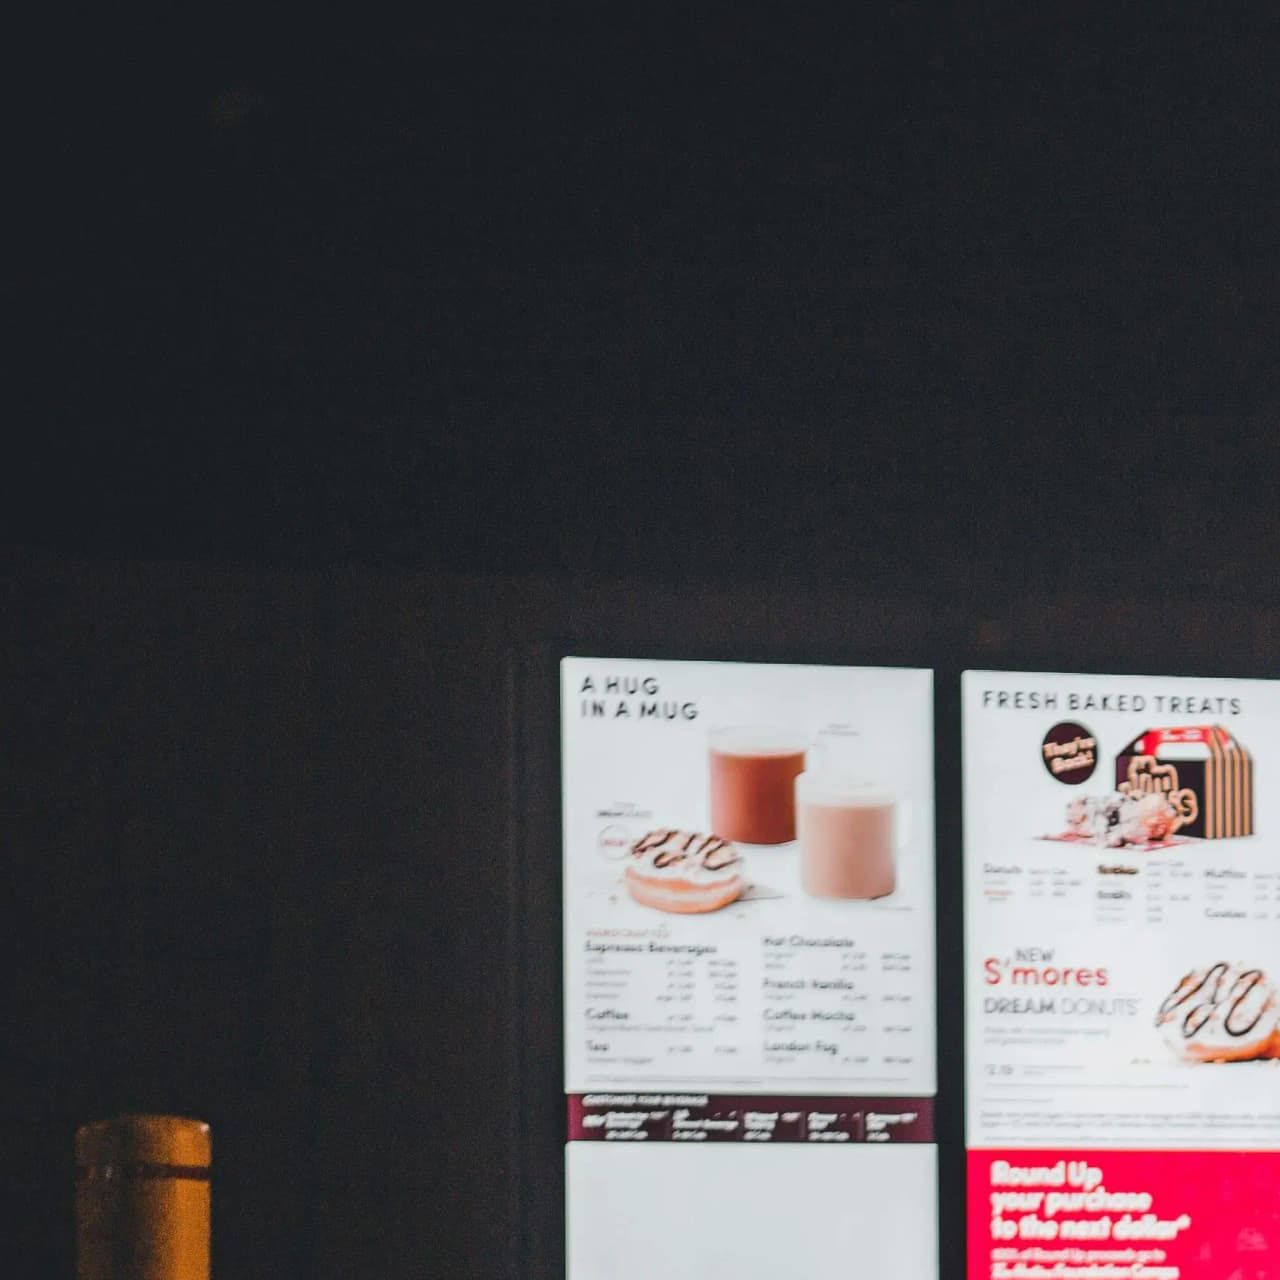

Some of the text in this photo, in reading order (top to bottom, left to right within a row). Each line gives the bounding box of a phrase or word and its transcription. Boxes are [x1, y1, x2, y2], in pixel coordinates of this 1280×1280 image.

[580, 676, 659, 696] A HUG
[581, 700, 699, 721] IN A MUG
[983, 690, 1242, 715] FRESH BAKED TREATS
[1015, 948, 1055, 963] NEW
[984, 958, 1109, 986] S'mores
[984, 998, 1055, 1015] DREAM
[990, 1160, 1103, 1191] Round Up
[990, 1186, 1152, 1217] your purchase
[990, 1216, 1018, 1240] to
[1019, 1214, 1058, 1240] the
[1059, 1217, 1112, 1240] next
